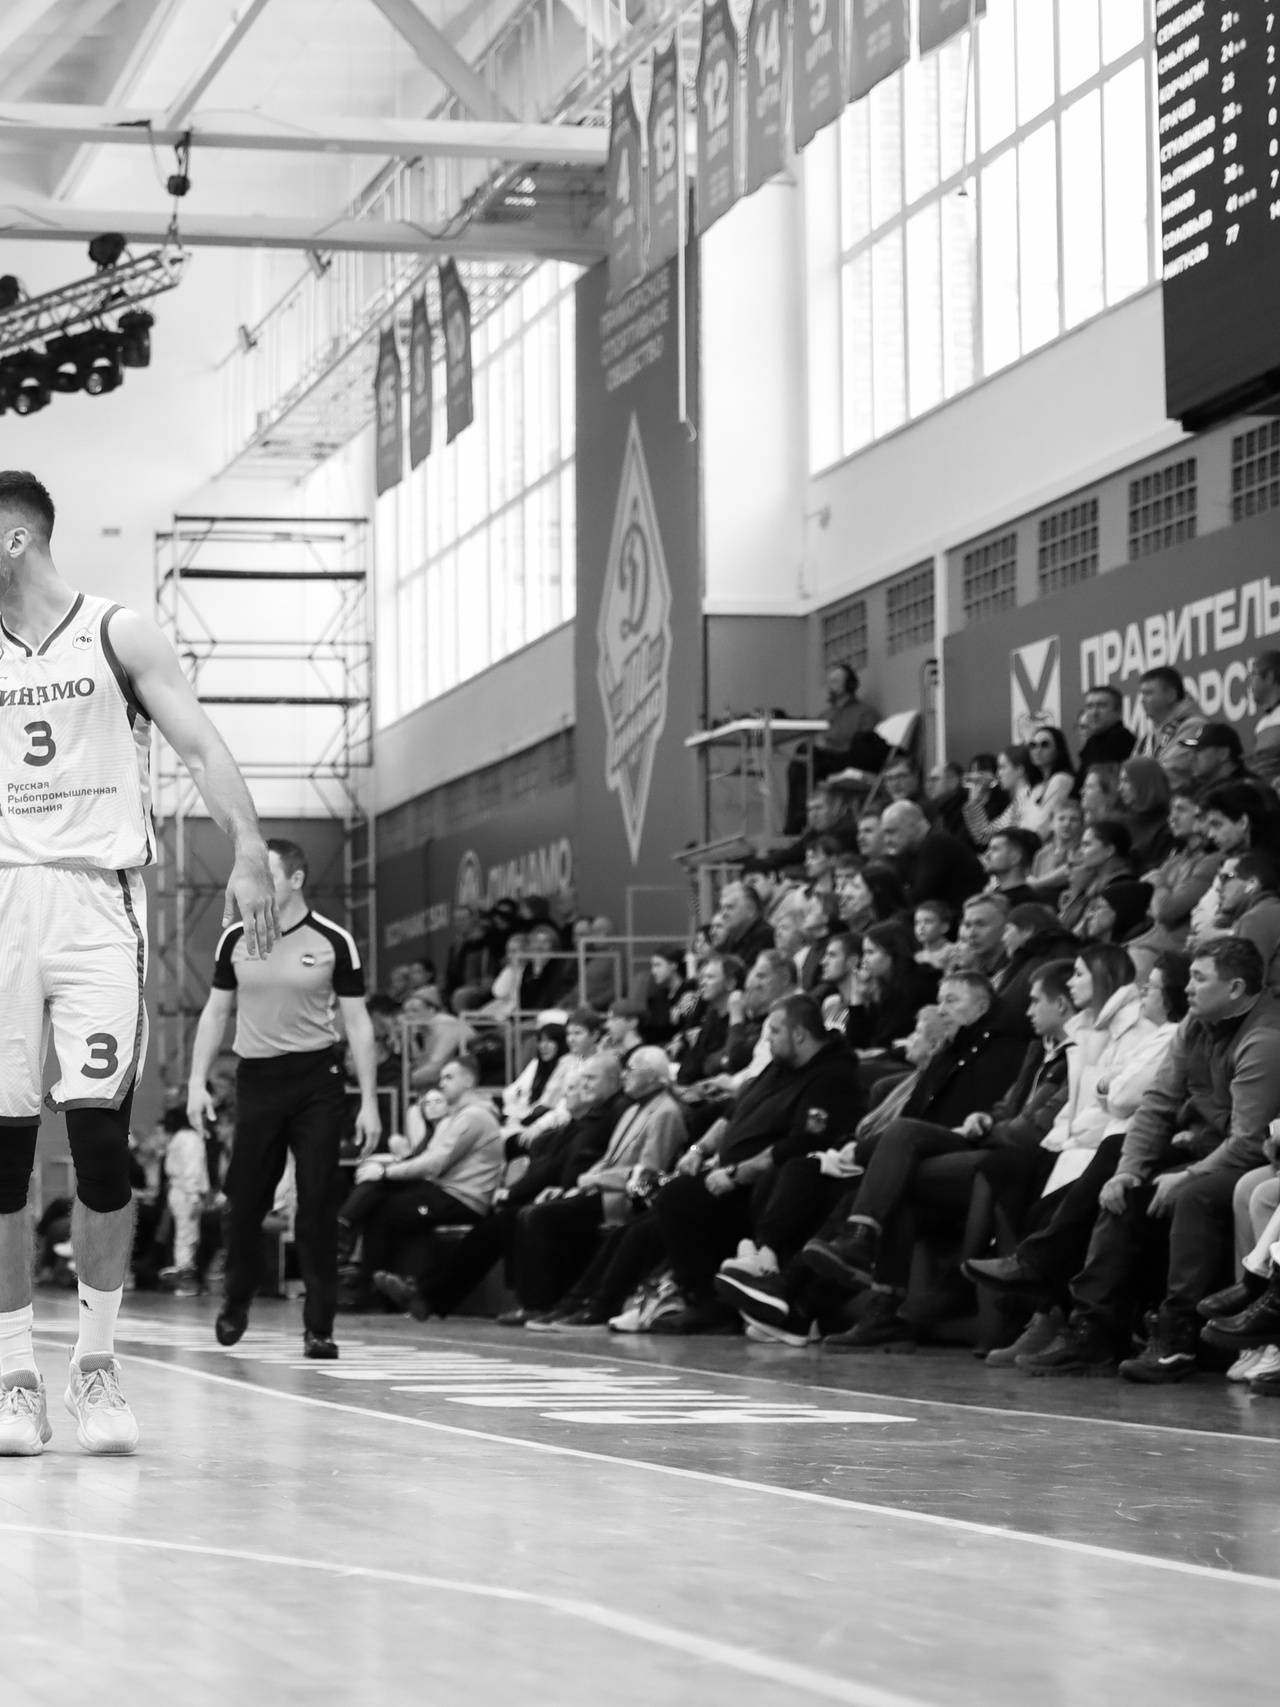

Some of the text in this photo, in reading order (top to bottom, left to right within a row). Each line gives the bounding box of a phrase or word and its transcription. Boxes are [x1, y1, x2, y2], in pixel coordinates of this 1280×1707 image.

[703, 59, 729, 132] 12
[1080, 575, 1280, 694] ПРАВИТЕЛЬ
[22, 720, 56, 767] 3
[7, 781, 50, 794] Русская
[7, 786, 117, 804] Рыбопромышленная
[7, 803, 63, 815] Компания
[81, 1032, 119, 1079] 3
